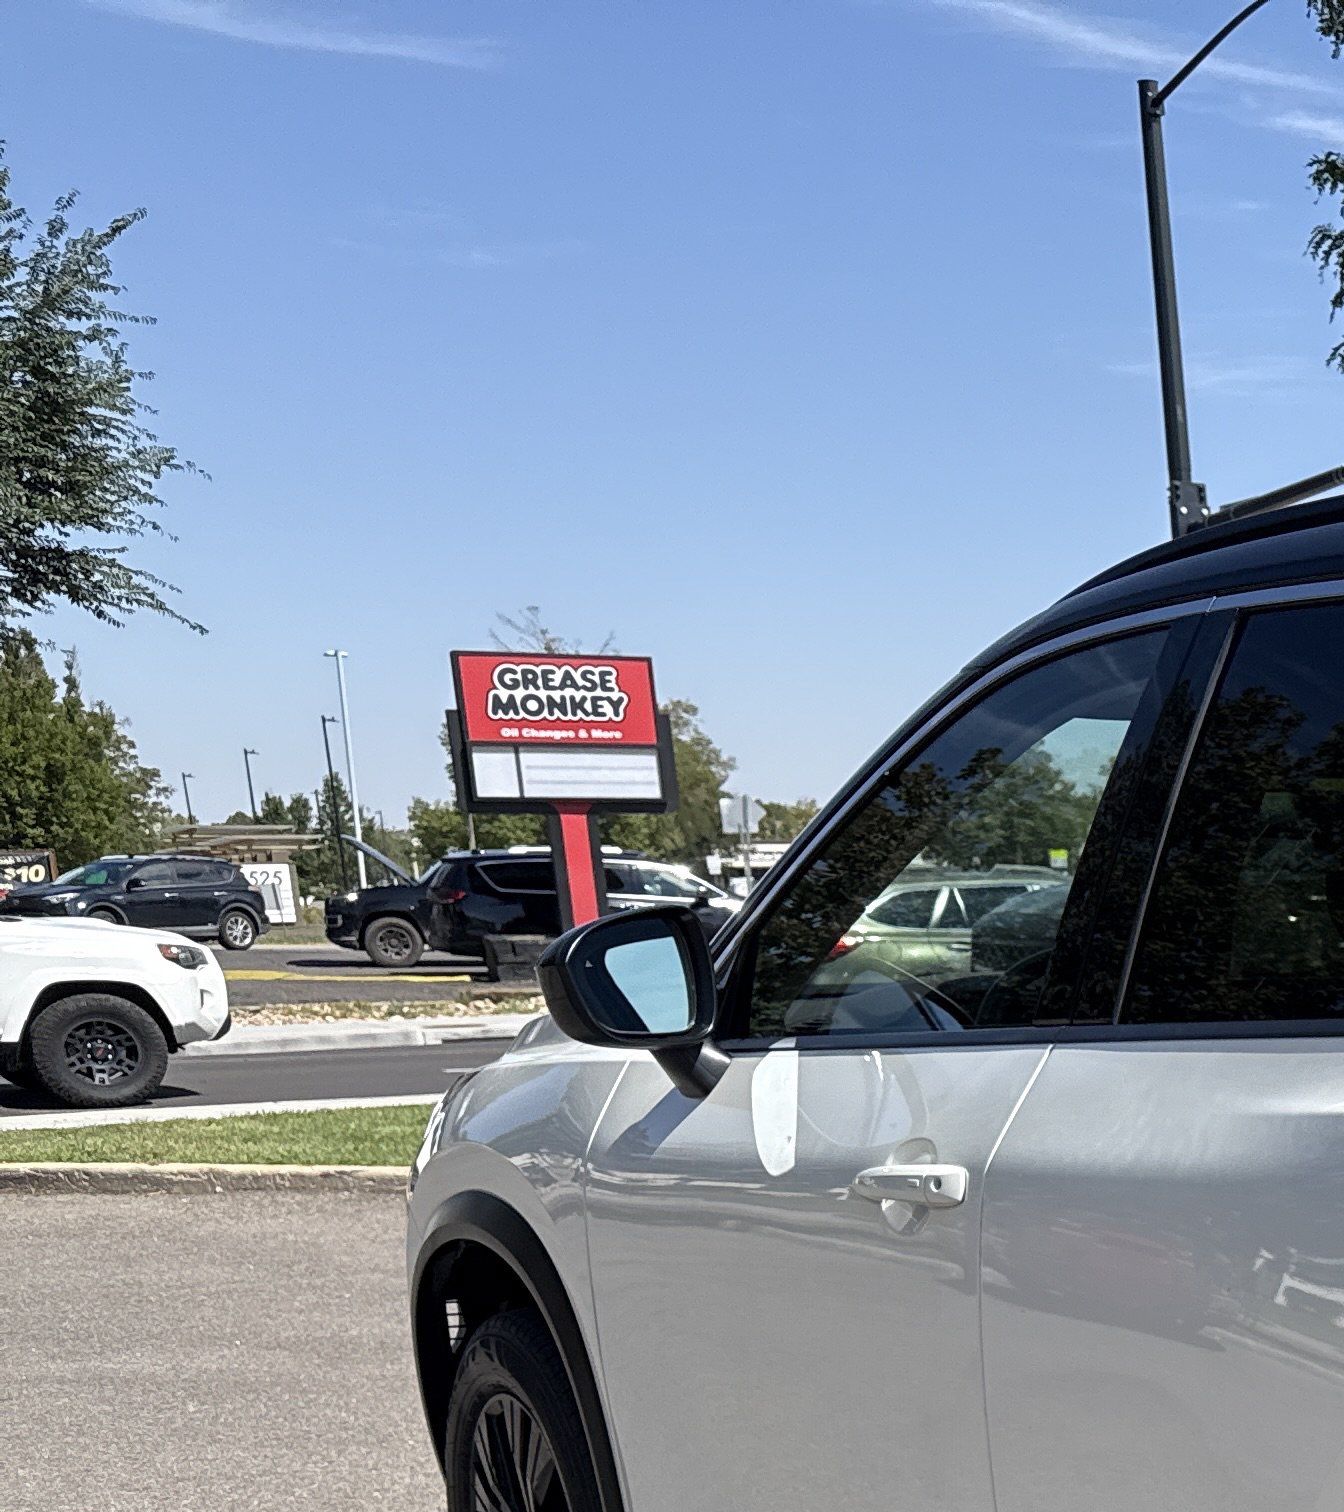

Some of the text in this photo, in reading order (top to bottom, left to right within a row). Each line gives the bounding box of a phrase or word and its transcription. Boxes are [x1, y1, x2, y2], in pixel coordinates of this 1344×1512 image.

[497, 667, 616, 693] GREASE
[491, 693, 625, 718] MONKEY
[500, 727, 623, 740] Oil Changes & More
